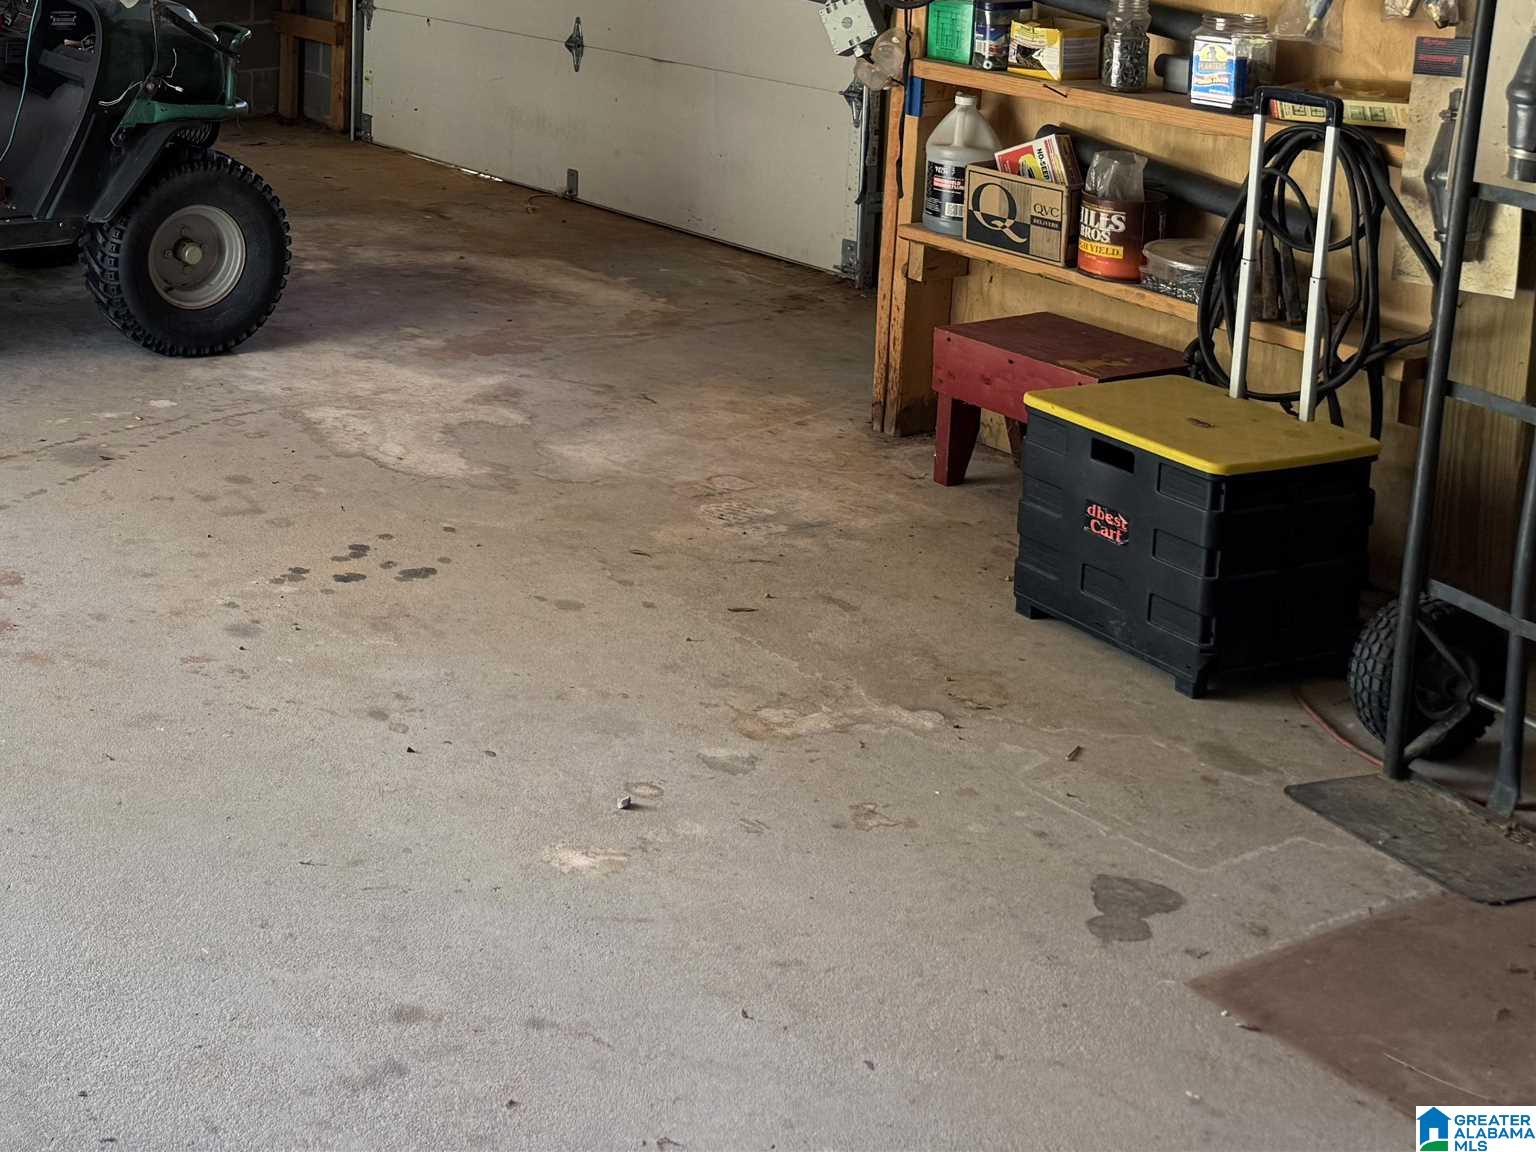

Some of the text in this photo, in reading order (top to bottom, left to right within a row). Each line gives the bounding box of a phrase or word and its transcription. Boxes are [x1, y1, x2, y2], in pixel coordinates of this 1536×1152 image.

[971, 182, 1028, 244] Q
[1033, 202, 1060, 219] QVC
[1087, 504, 1129, 530] dbest
[1090, 519, 1123, 544] Cart
